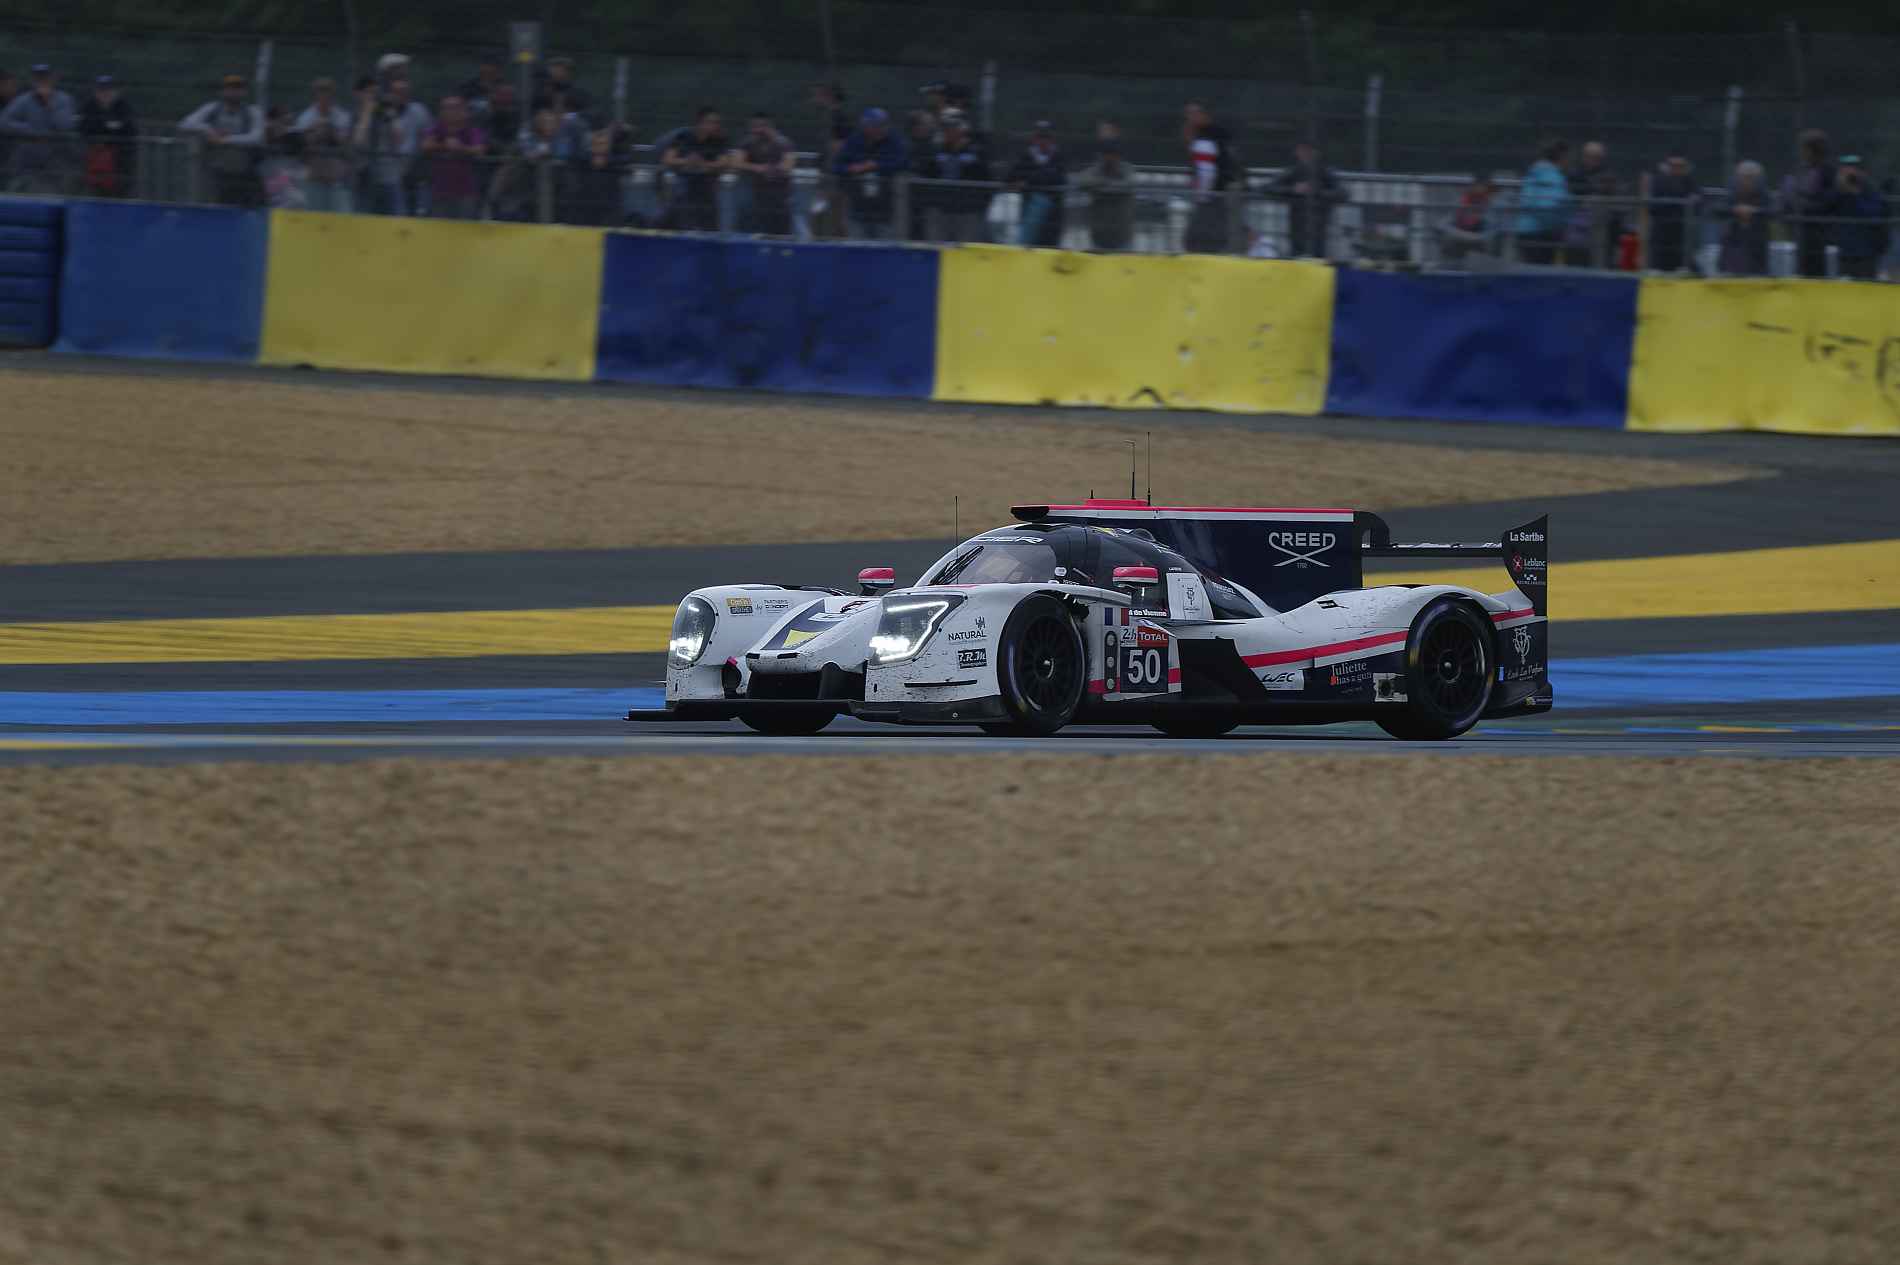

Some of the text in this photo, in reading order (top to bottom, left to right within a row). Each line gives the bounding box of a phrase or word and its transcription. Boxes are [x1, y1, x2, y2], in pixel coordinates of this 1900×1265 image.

[1268, 531, 1336, 548] CREED
[1509, 532, 1544, 542] La Sarthe
[948, 630, 987, 641] NATURAL
[1127, 648, 1161, 684] 50
[1331, 662, 1367, 677] Juliette
[1261, 672, 1296, 683] WEC
